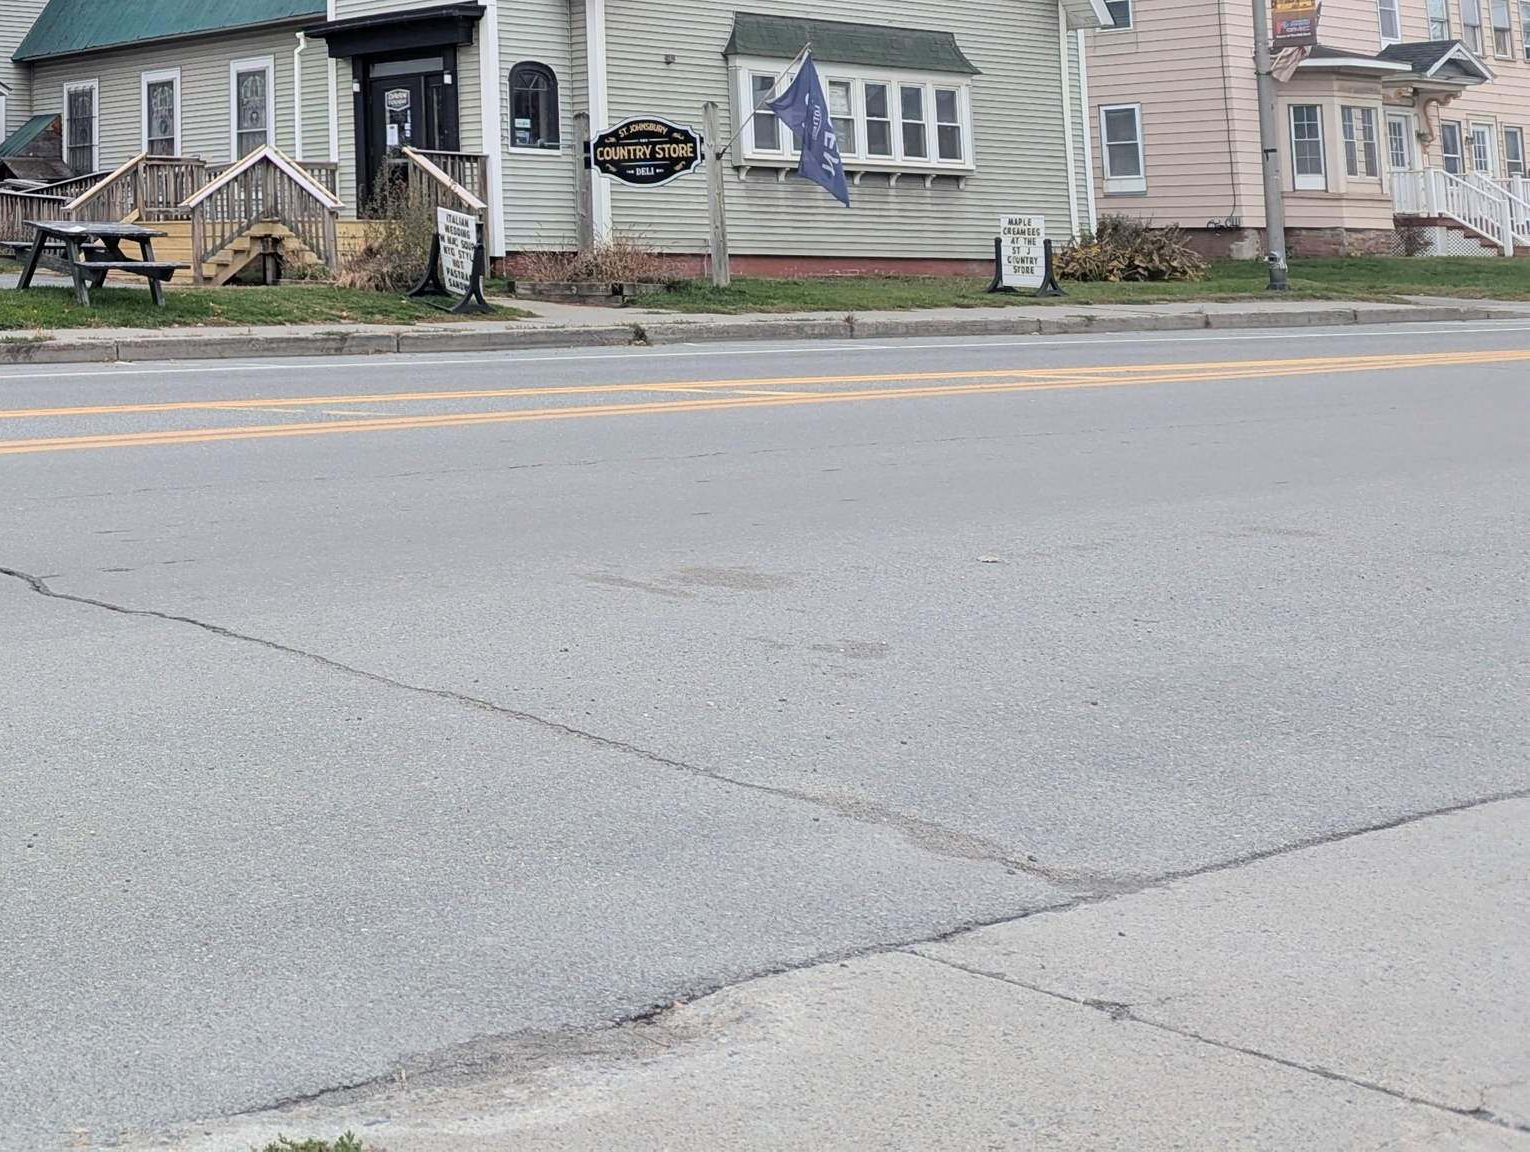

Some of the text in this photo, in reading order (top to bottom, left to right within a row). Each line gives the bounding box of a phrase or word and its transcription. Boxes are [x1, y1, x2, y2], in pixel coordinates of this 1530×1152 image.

[629, 122, 668, 135] JOHNSBURY
[596, 143, 694, 160] COUNTRY STORE
[636, 167, 654, 176] DELI
[446, 213, 469, 228] ITALIAN
[1008, 218, 1032, 226] MAPLE
[444, 224, 470, 239] WEDDING
[1002, 227, 1040, 236] CREAMEES
[1011, 237, 1036, 246] AT THE
[458, 250, 473, 261] STYL
[1012, 247, 1031, 255] ST J
[1007, 256, 1038, 265] COUNTRY
[447, 267, 470, 281] PASTRA
[1013, 266, 1034, 275] STORE
